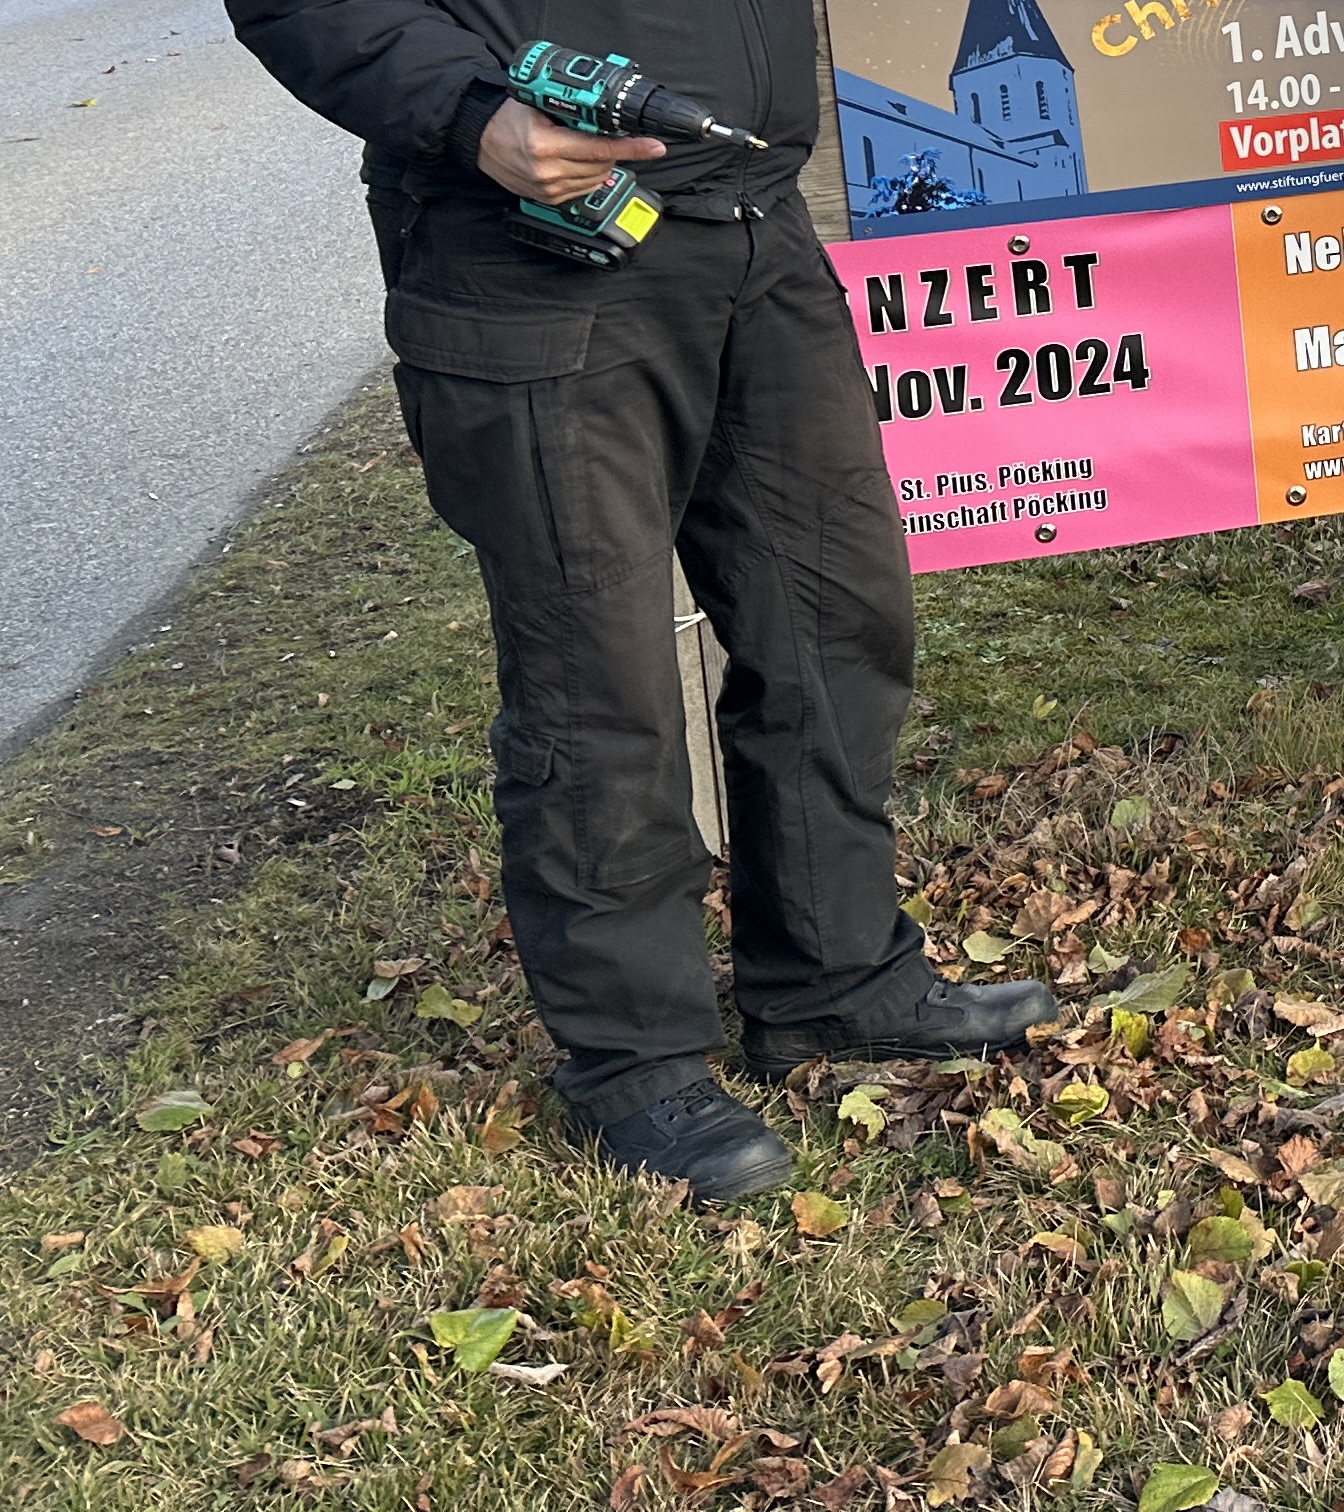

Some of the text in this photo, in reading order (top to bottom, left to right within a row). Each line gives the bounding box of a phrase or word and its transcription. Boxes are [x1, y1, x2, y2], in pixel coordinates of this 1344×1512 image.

[1221, 21, 1263, 64] 1.
[1226, 73, 1322, 113] 14.00
[865, 252, 1099, 335] NZERT
[996, 333, 1151, 408] 2024
[900, 457, 1093, 501] St. Pius, Pöcking
[901, 488, 1108, 535] einschaft Pöcking
